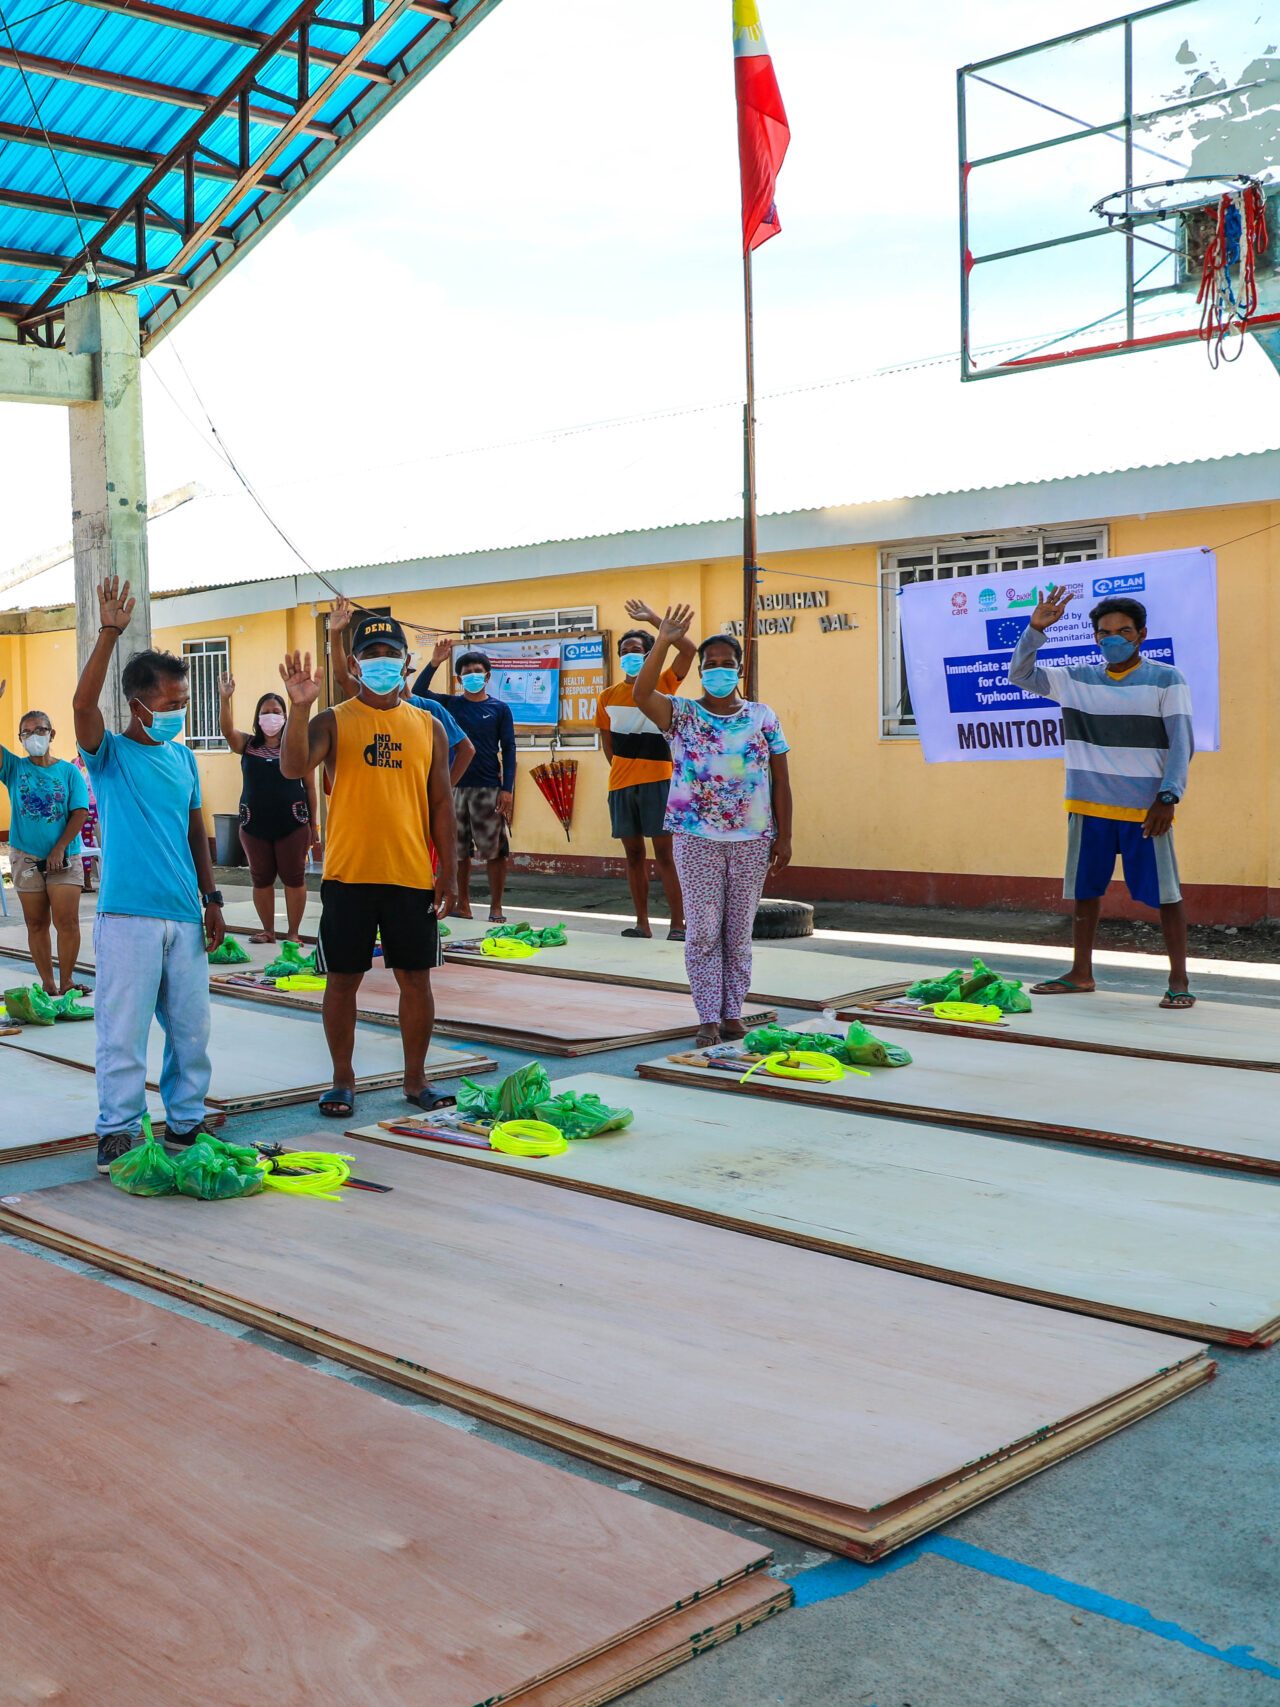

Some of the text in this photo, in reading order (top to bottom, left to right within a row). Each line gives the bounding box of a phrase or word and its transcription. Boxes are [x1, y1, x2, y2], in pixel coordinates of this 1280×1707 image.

[1114, 577, 1143, 587] PLAN
[755, 590, 828, 611] ABULIHAN
[952, 608, 968, 616] care
[1072, 612, 1082, 620] by
[365, 623, 392, 635] DENR
[720, 616, 795, 637] BARNGAY
[1044, 623, 1079, 632] uropean
[580, 645, 602, 654] PLAN
[946, 661, 999, 674] Immediate
[563, 675, 603, 685] HEALTH AND
[978, 676, 993, 687] for
[565, 686, 594, 695] RESPONSE
[976, 690, 1020, 705] Typhoon
[578, 698, 597, 720] RA
[377, 734, 391, 742] NO
[957, 718, 1065, 750] MONITORI
[378, 743, 402, 751] PAIN
[378, 751, 391, 759] NO
[378, 759, 402, 768] GAIN
